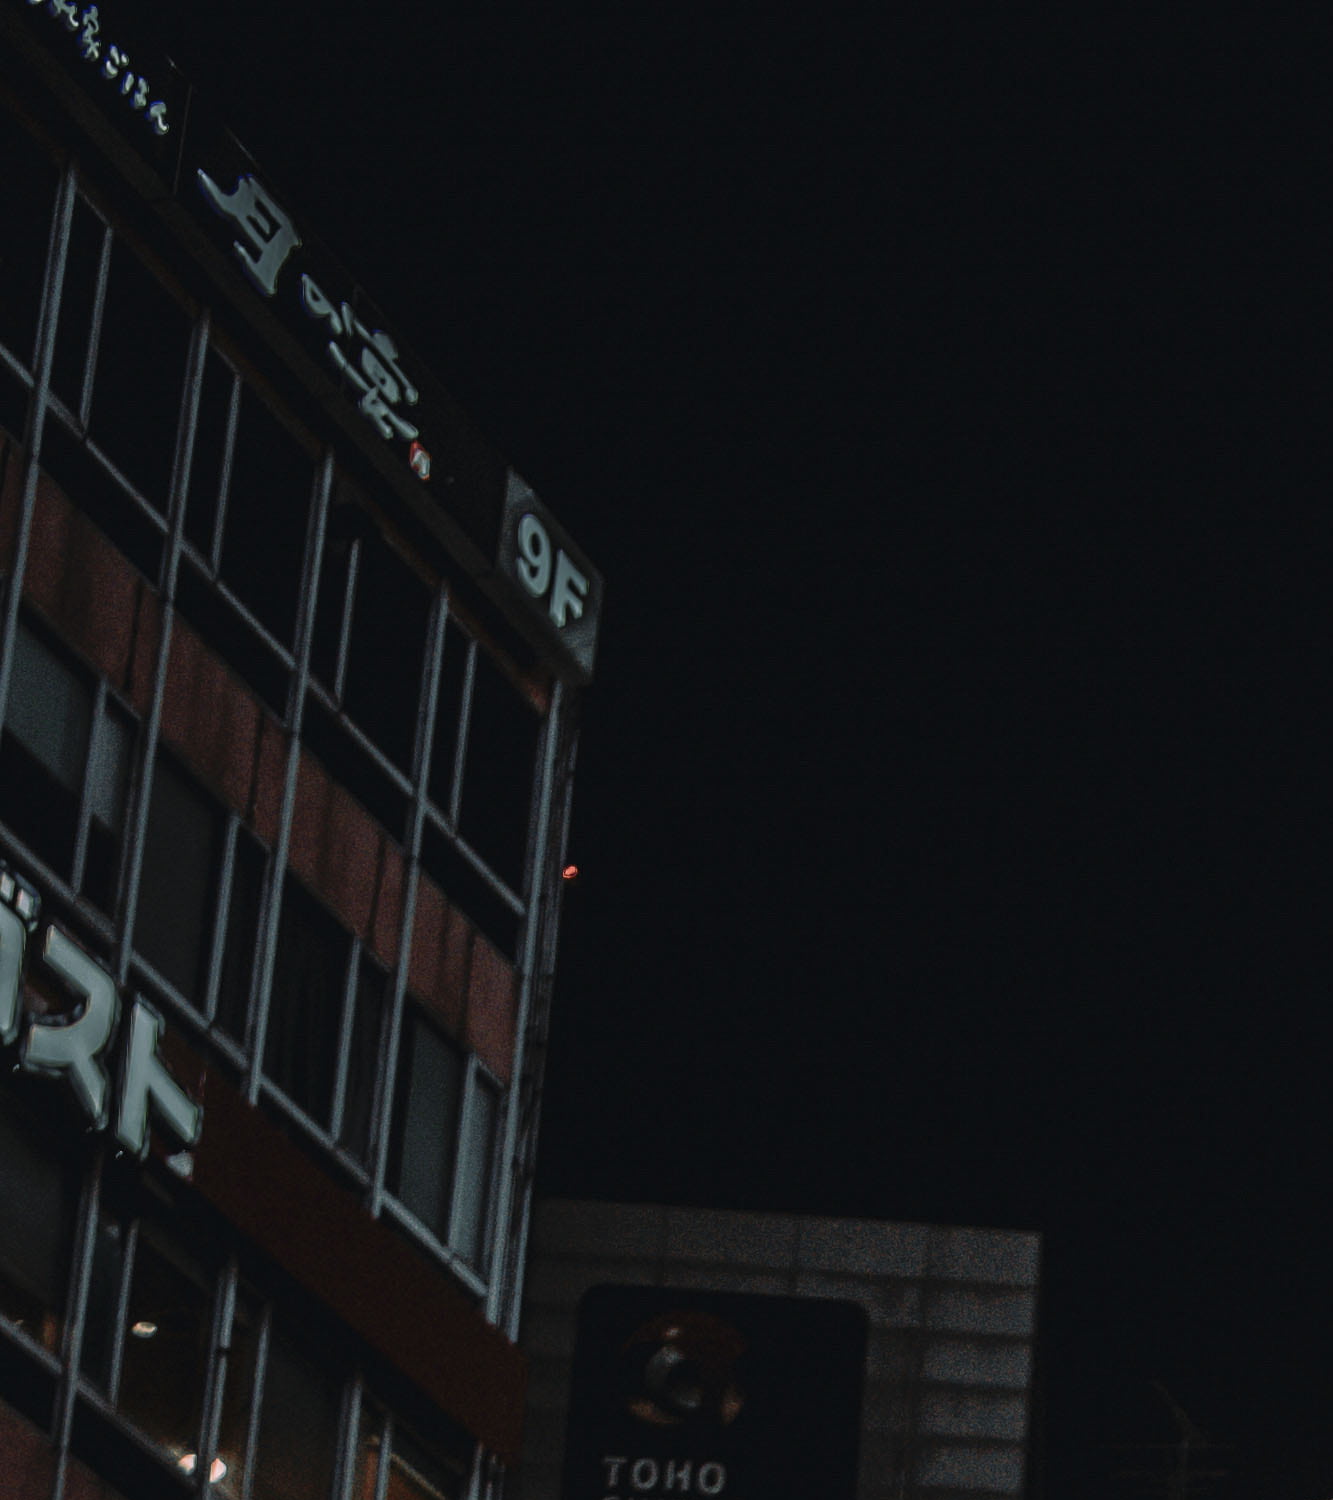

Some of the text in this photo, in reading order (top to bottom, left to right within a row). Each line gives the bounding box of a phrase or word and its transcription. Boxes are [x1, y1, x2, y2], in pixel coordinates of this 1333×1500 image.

[517, 513, 590, 628] 9F
[0, 862, 202, 1162] スト
[604, 1456, 727, 1495] TOHO
